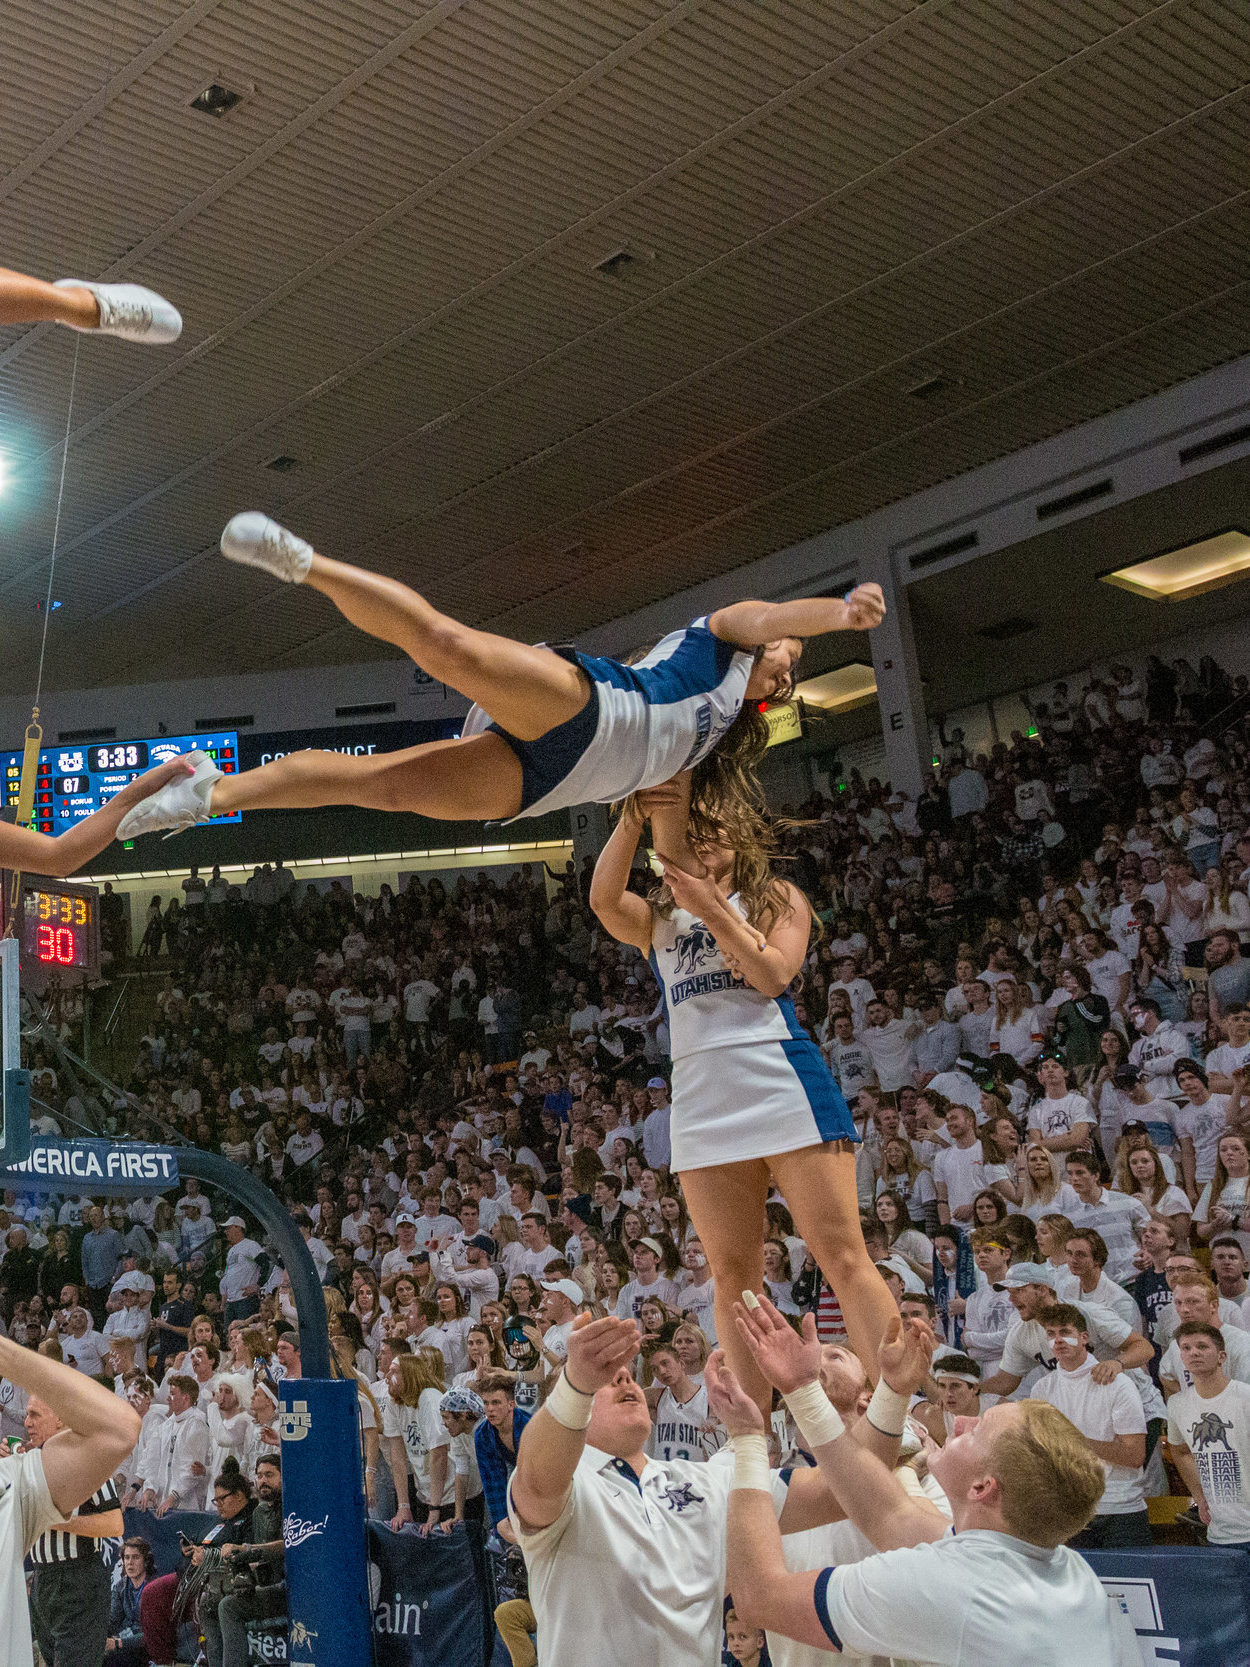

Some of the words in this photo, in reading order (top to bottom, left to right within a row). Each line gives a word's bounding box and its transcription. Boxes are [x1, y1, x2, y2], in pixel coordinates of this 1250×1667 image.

[890, 712, 903, 731] E
[97, 746, 138, 768] 3:33
[7, 768, 19, 777] 05
[39, 893, 87, 925] 3:33
[38, 924, 75, 963] 30
[670, 973, 710, 1006] UTAH
[107, 1152, 172, 1178] FIRST
[1211, 1459, 1239, 1467] STATE
[1213, 1474, 1240, 1482] STATE
[285, 1515, 329, 1548] Sabor!
